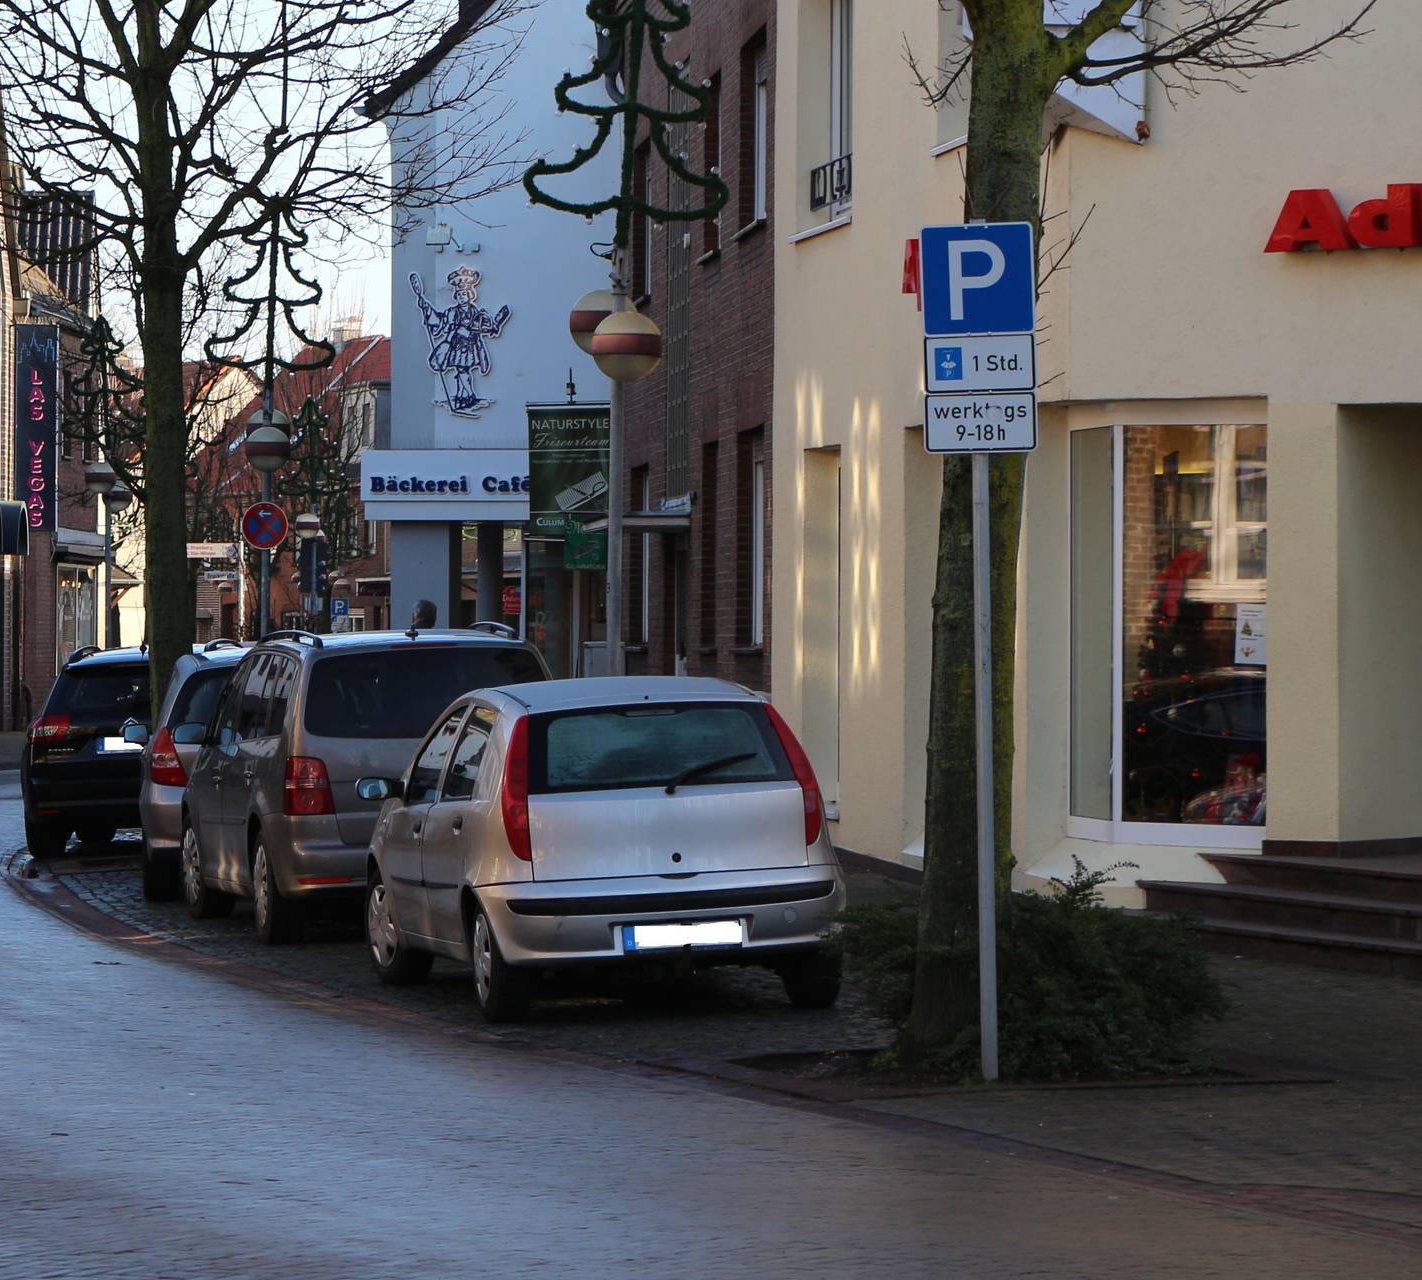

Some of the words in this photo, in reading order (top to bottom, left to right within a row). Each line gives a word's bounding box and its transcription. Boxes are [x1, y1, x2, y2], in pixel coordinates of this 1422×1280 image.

[948, 239, 1005, 321] P
[973, 355, 978, 372] 1
[986, 354, 1023, 371] Std.
[29, 368, 45, 421] LAS
[934, 402, 1027, 422] werkgs
[531, 418, 609, 430] NATURSTYLE
[27, 440, 45, 528] VEGAS
[370, 475, 469, 493] Bäckerei
[482, 475, 530, 493] Café
[536, 517, 565, 526] CULUM
